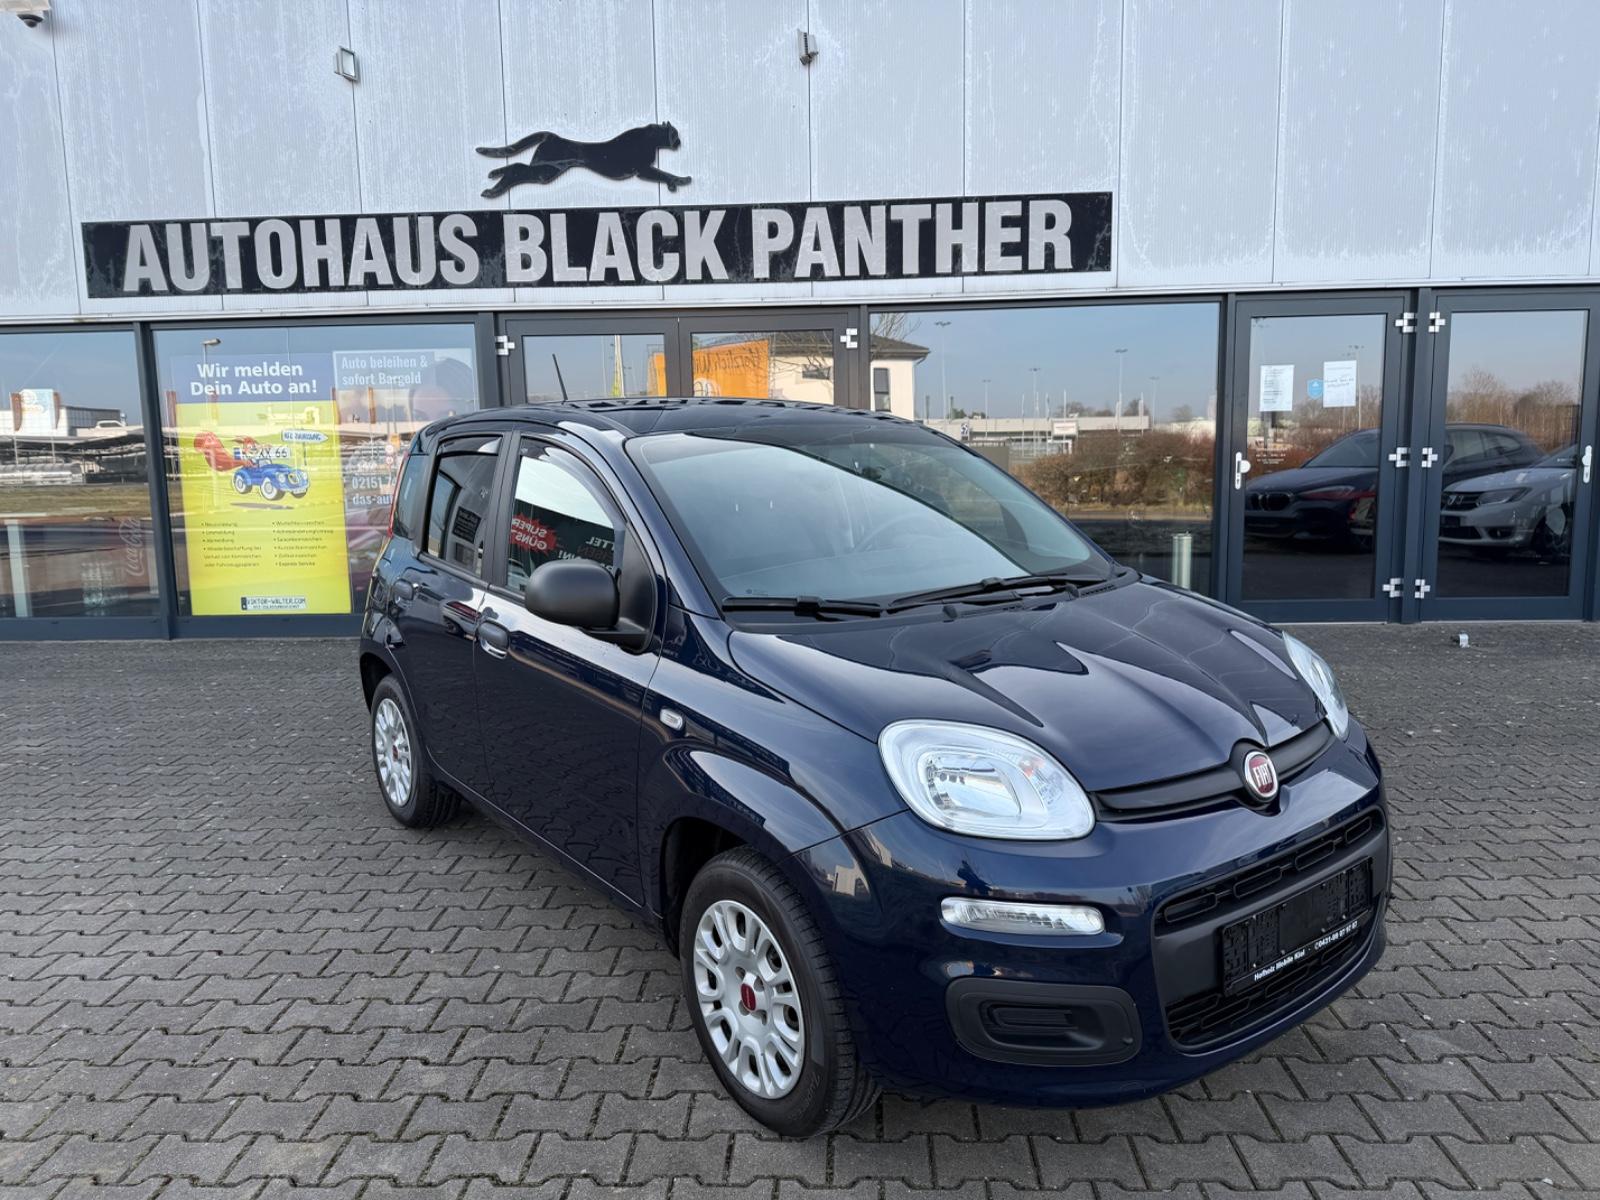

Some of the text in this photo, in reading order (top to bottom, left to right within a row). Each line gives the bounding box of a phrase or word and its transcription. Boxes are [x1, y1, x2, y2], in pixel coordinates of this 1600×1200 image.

[123, 199, 1074, 292] AUTOHAUS BLACK PANTHER
[197, 361, 303, 378] Wir melden
[342, 354, 428, 369] Auto beleihen &
[190, 379, 317, 396] Dein Auto an!
[342, 371, 422, 387] sofort Bargeld
[352, 475, 383, 490] 02151
[1252, 763, 1273, 788] FIAT
